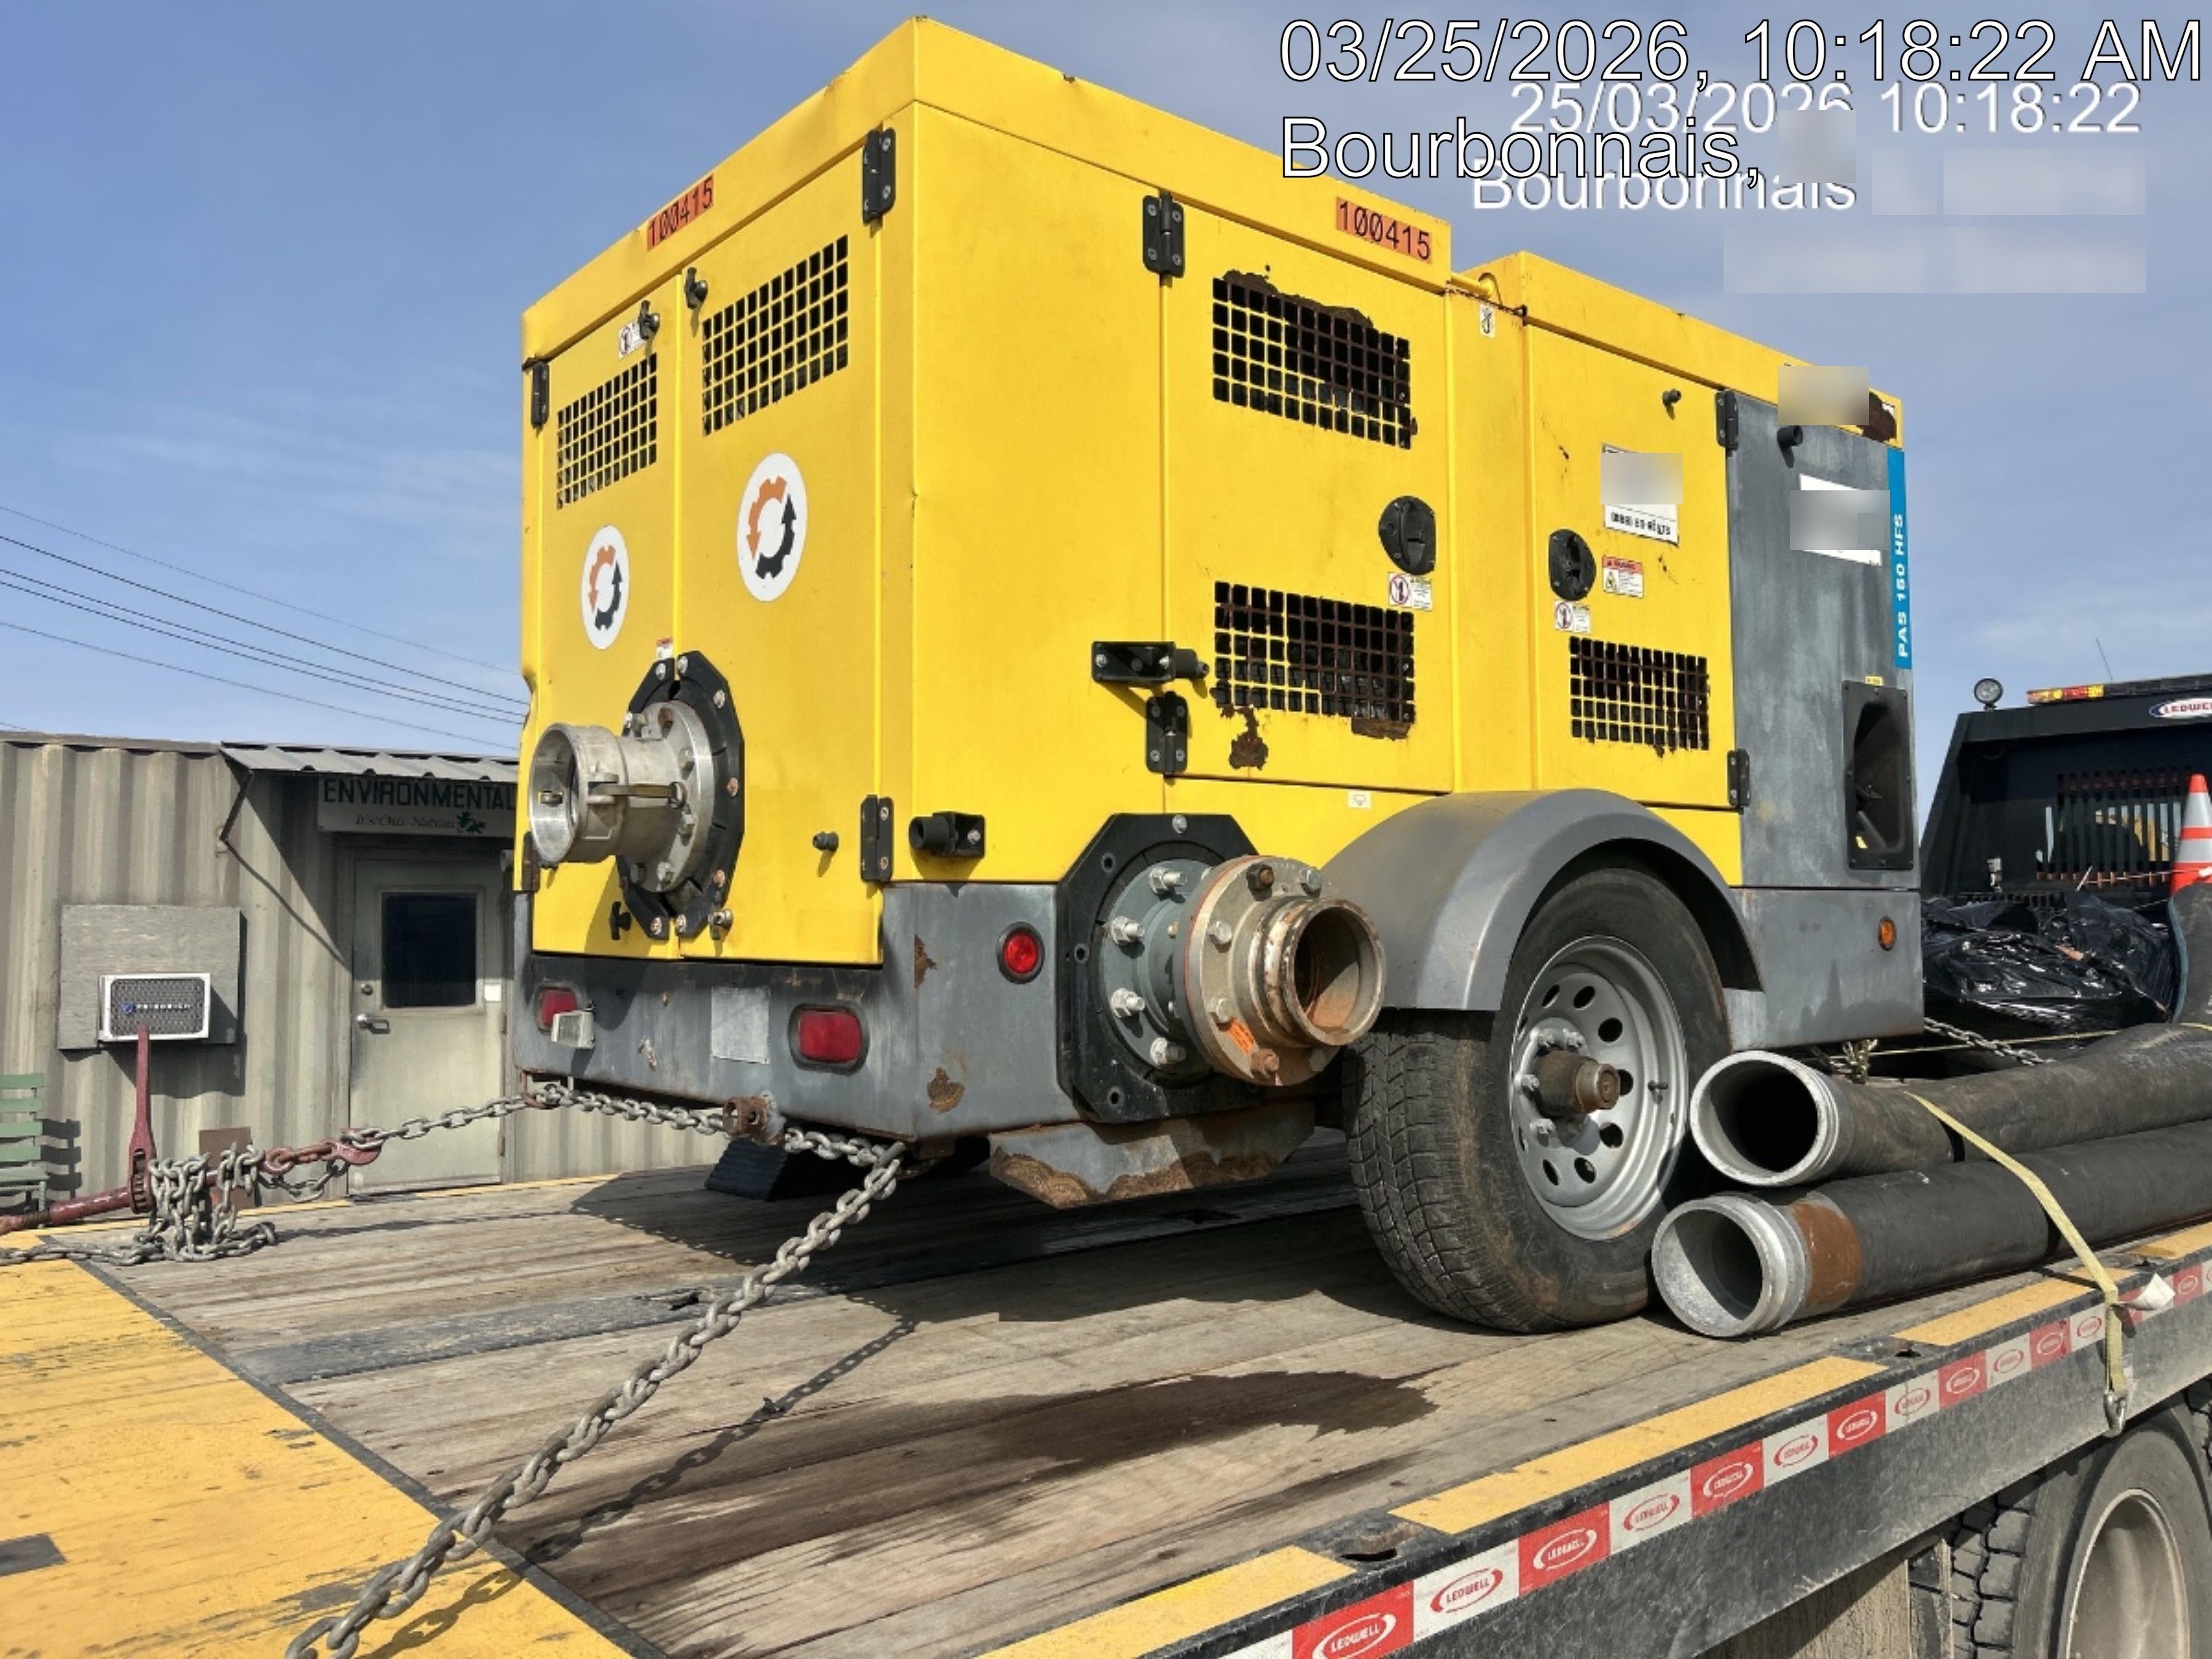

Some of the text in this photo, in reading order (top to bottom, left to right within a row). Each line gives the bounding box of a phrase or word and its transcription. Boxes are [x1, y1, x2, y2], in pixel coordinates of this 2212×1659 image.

[649, 176, 713, 246] 100415
[1339, 200, 1430, 261] 100415
[1894, 513, 1904, 555] HFS
[1897, 611, 1908, 657] PAS
[323, 778, 515, 810] ENVIRONMENTAL
[1446, 1577, 1491, 1605] LEDWELL
[1329, 1622, 1381, 1653] LEDWELL
